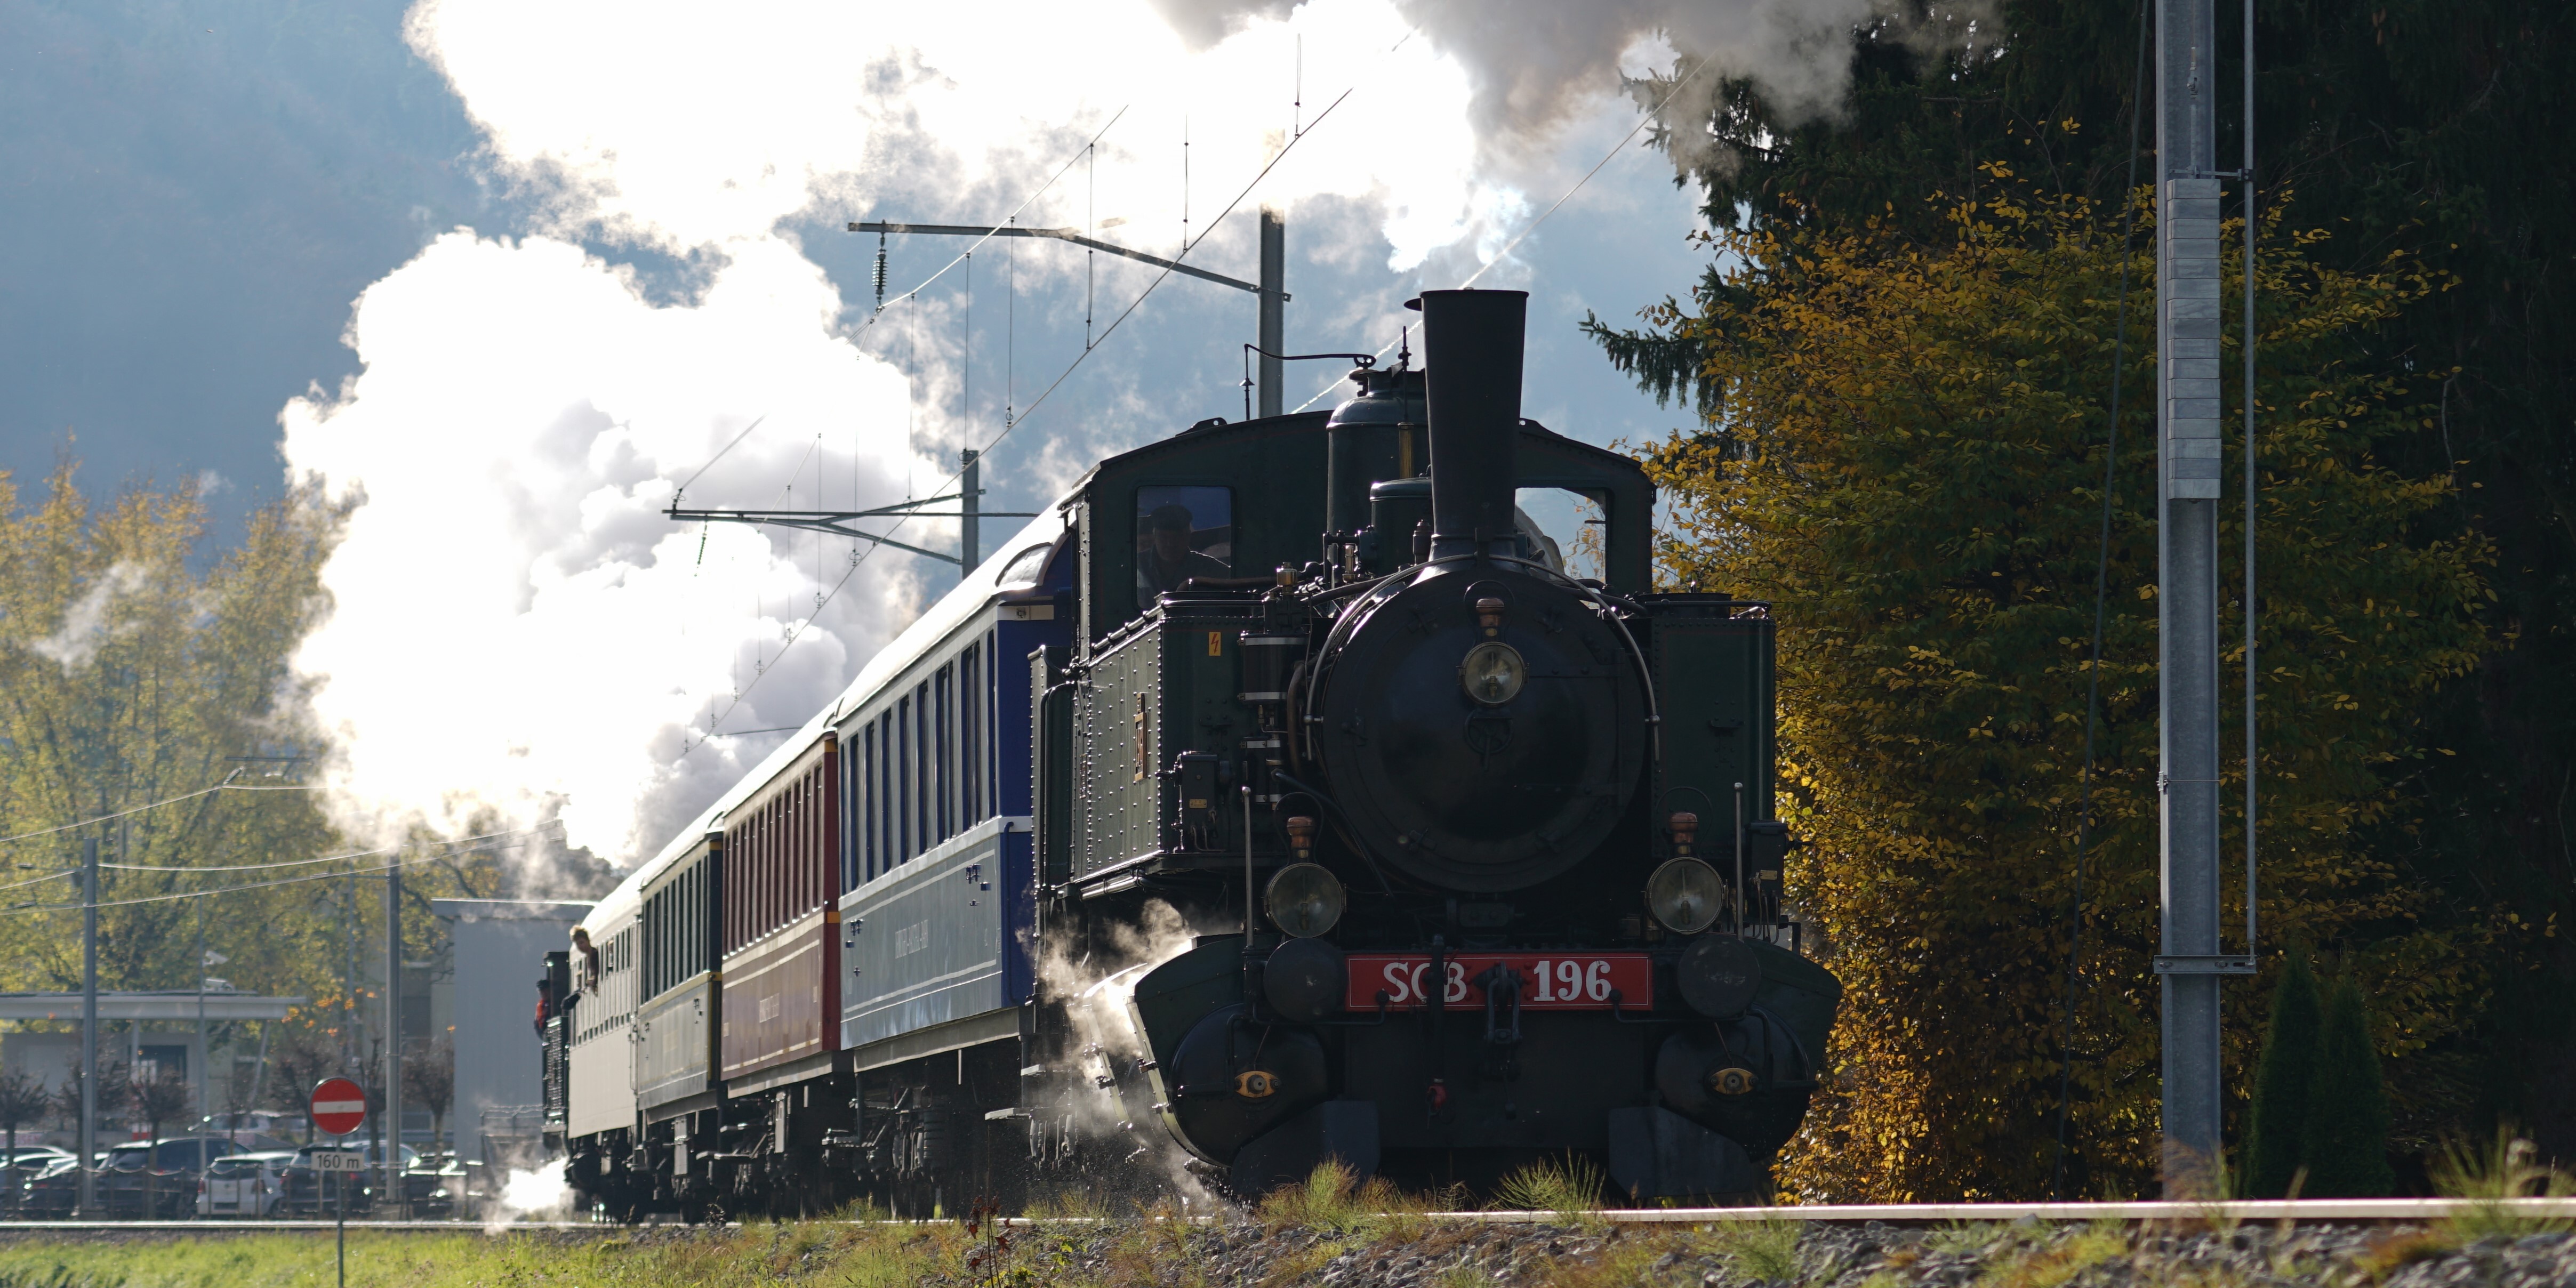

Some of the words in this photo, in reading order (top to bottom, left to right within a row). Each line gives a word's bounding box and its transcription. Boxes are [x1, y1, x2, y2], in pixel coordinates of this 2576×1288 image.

[1534, 960, 1611, 1001] 196
[317, 1154, 340, 1168] 160
[347, 1158, 359, 1169] m
